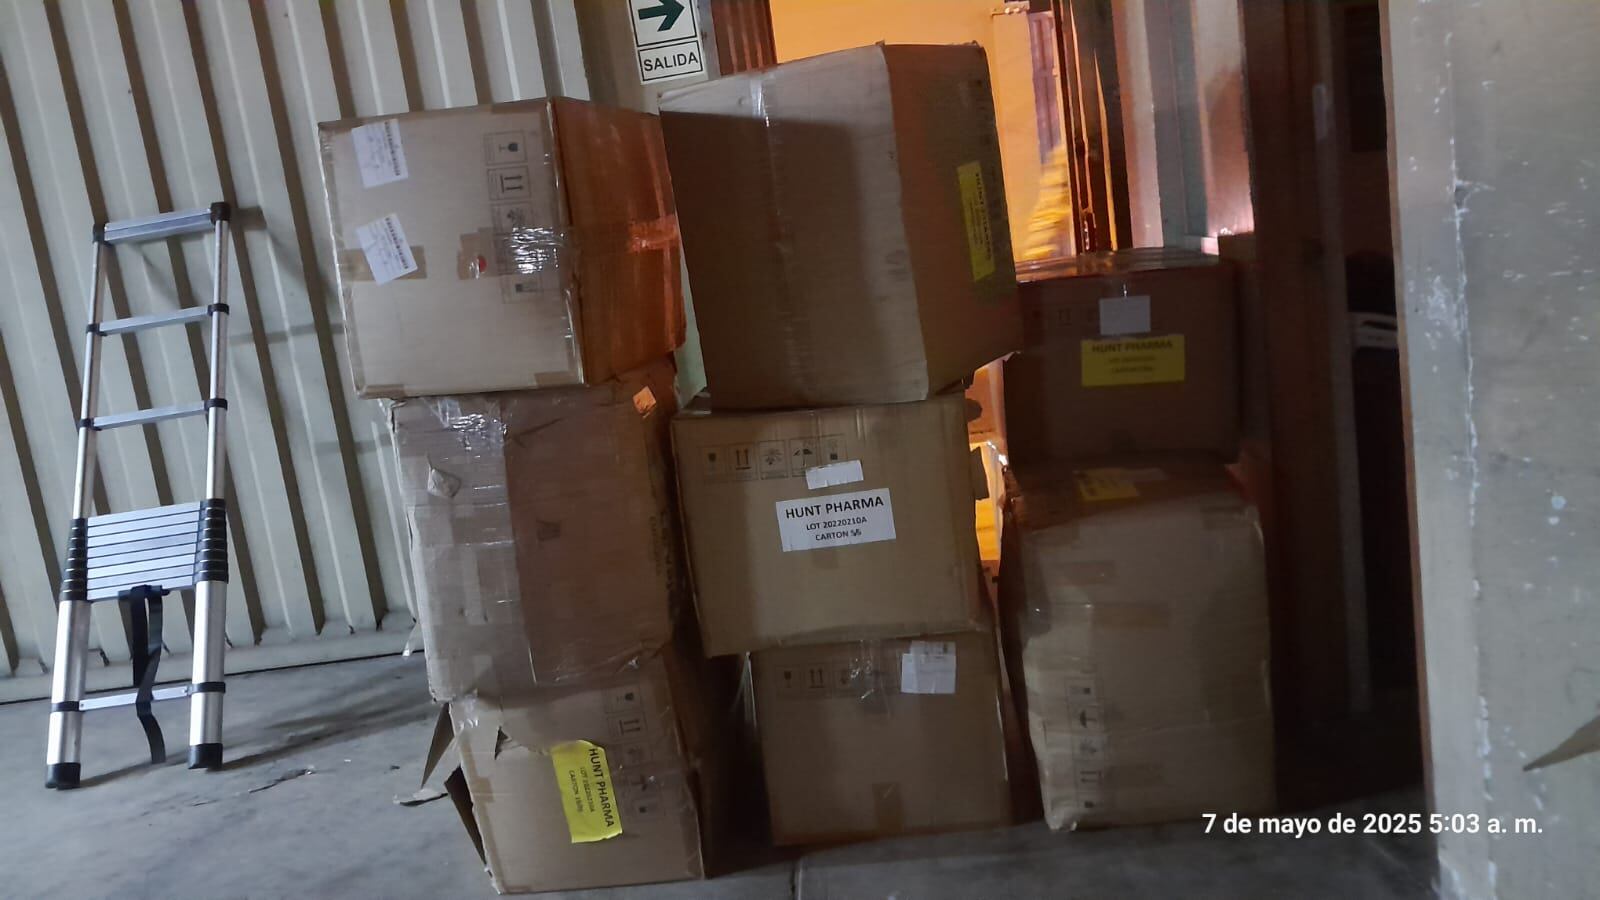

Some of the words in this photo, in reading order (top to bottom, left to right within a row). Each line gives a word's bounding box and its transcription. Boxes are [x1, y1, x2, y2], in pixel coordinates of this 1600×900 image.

[643, 51, 699, 72] SALIDA
[785, 504, 821, 519] HUNT
[825, 496, 884, 514] PHARMA
[806, 522, 821, 531] LOT
[823, 516, 868, 529] 20220210A
[815, 530, 849, 541] CARTON
[588, 748, 603, 778] HUNT
[596, 781, 615, 828] PHARMA
